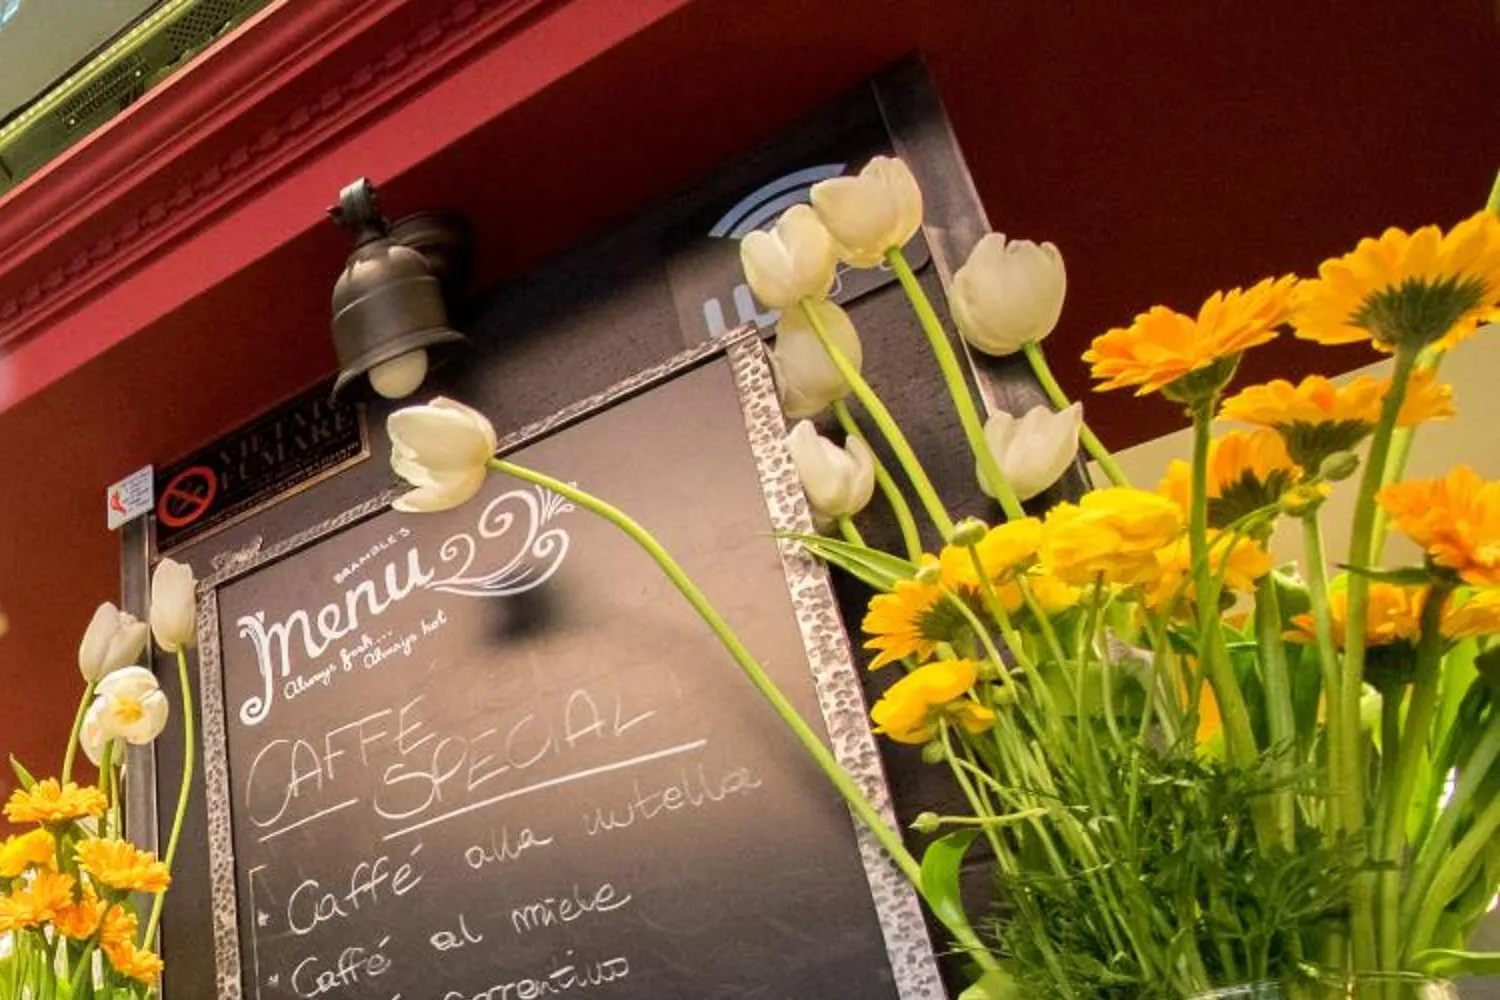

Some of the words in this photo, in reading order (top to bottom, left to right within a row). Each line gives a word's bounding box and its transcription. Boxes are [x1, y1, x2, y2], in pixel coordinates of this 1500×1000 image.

[421, 608, 447, 635] hot
[464, 827, 553, 869] alla
[581, 760, 763, 836] nutella
[430, 914, 483, 951] al
[511, 882, 632, 933] miele
